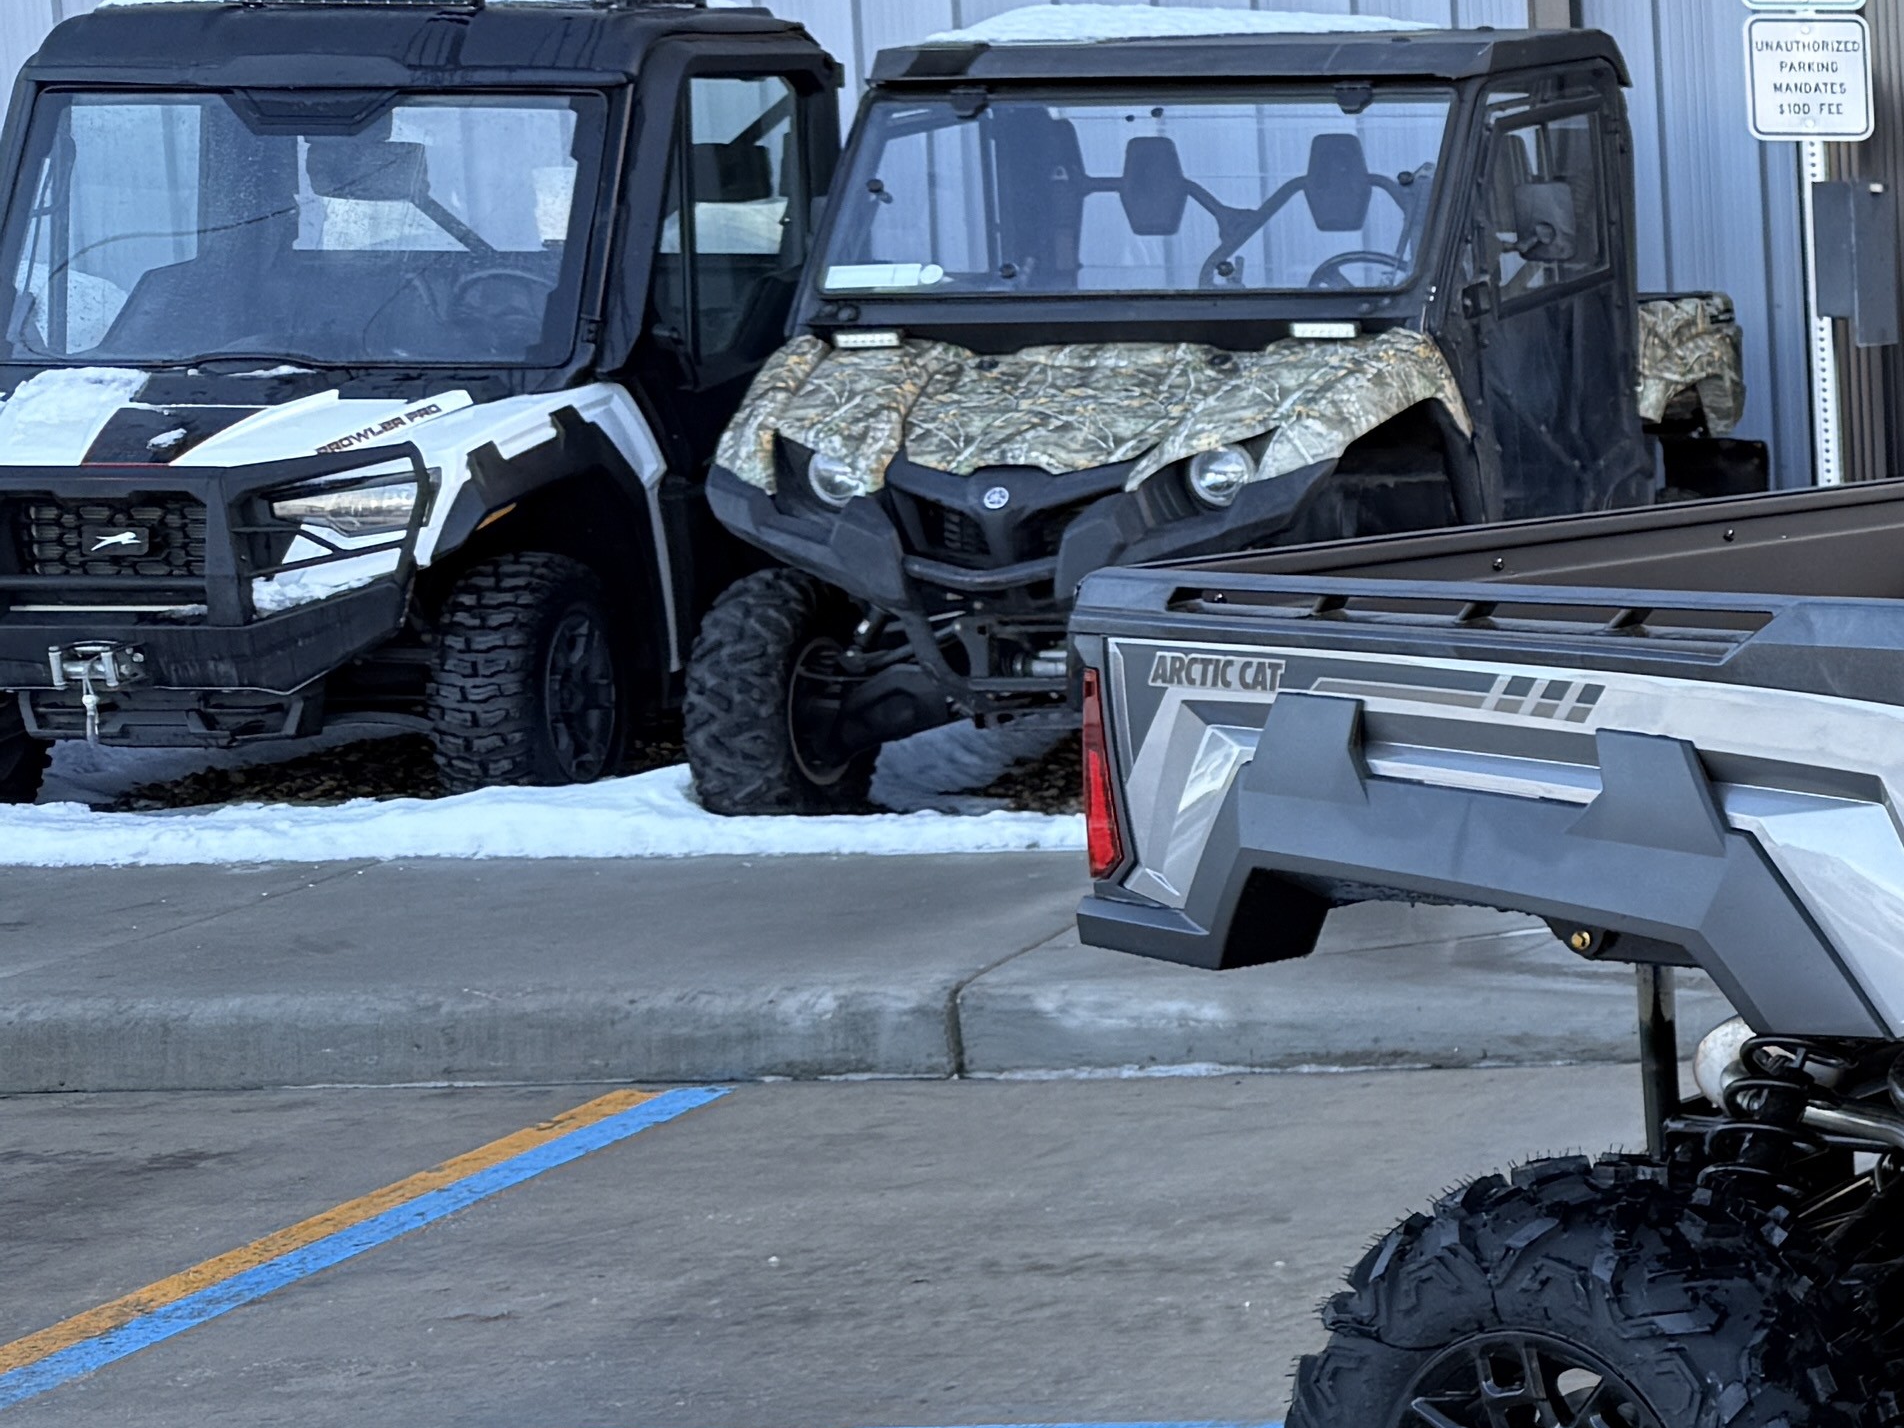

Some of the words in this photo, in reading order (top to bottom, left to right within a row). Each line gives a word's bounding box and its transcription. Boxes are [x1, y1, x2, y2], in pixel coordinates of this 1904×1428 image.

[1755, 40, 1861, 53] UNAUTHORIZED
[1779, 60, 1839, 73] PARKING
[1773, 82, 1847, 94] MANDATES
[1778, 102, 1811, 115] $100
[1819, 102, 1844, 115] FEE
[315, 416, 407, 454] PROWLER
[404, 403, 443, 423] PRO
[1150, 654, 1235, 689] ARCTIC
[1238, 660, 1284, 692] CAT
